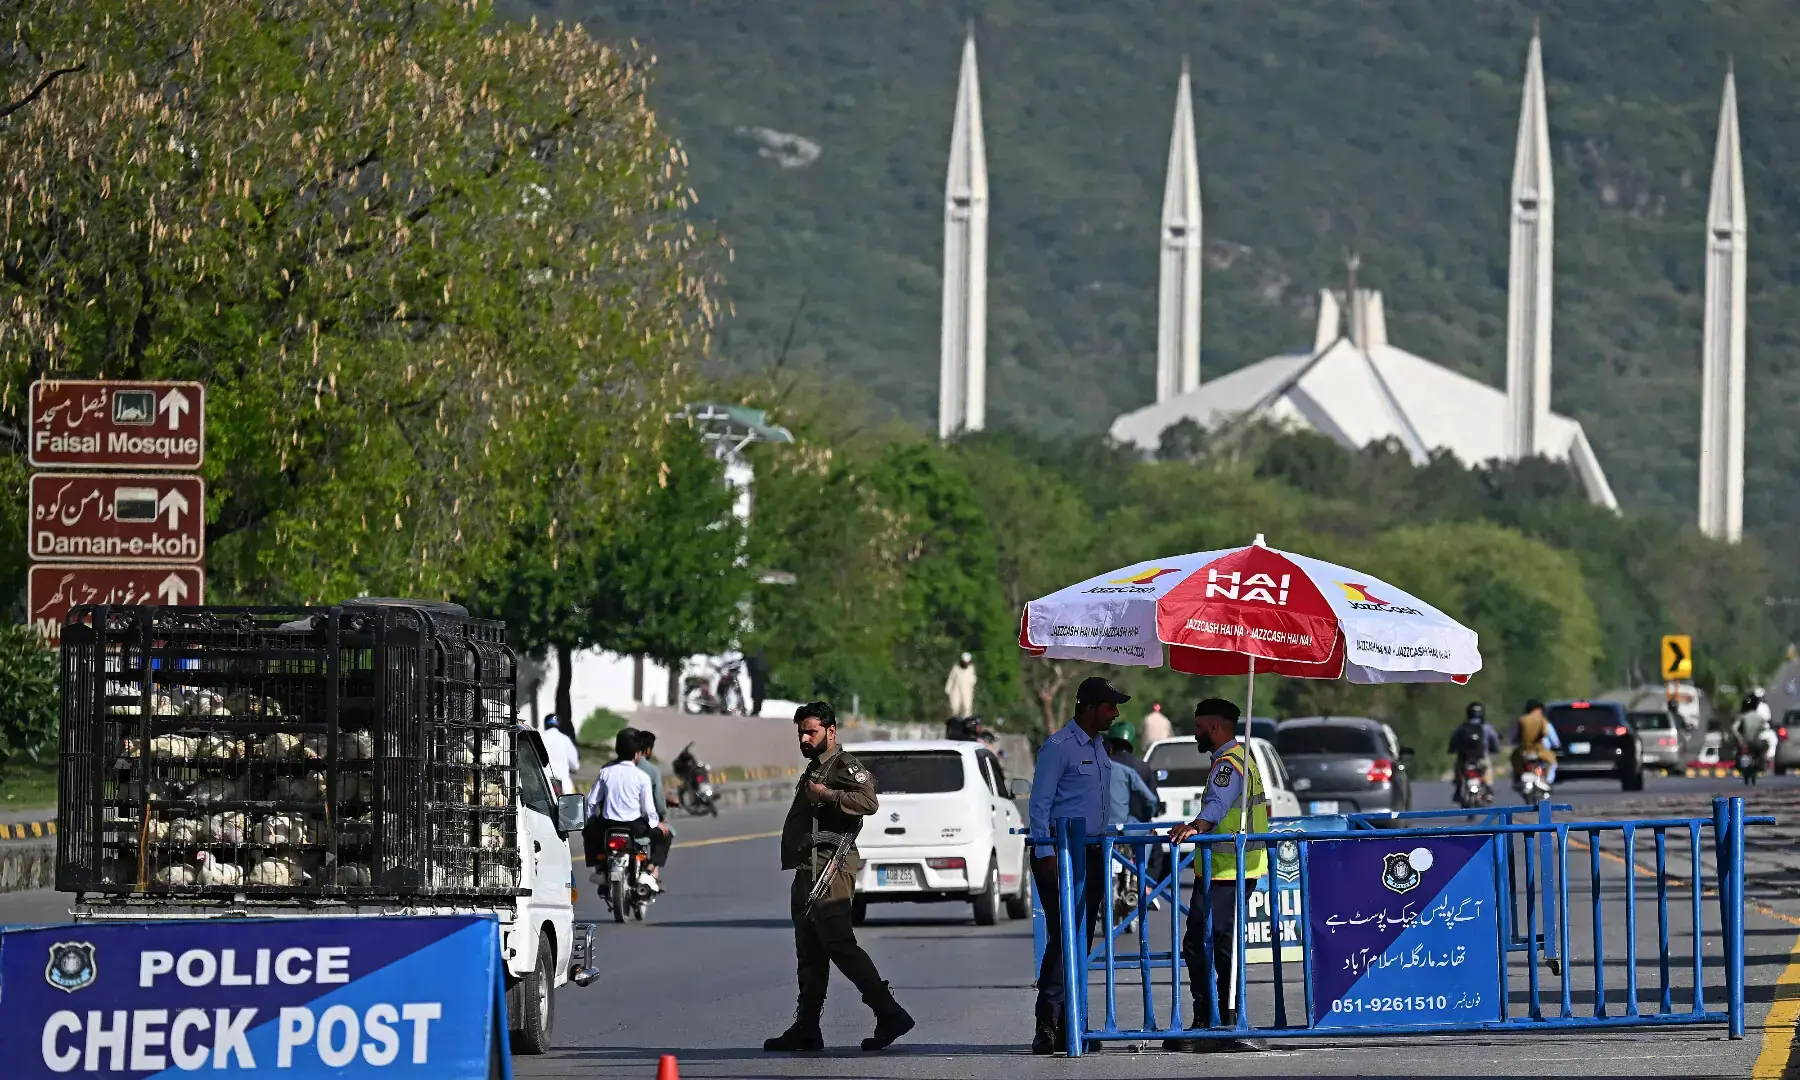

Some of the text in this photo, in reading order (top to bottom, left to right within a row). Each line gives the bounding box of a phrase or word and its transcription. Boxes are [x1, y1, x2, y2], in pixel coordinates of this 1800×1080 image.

[35, 387, 107, 431] فیصل مسجد
[35, 431, 198, 458] Faisal Mosque
[36, 480, 114, 526] دامن کوہ
[37, 531, 197, 555] Daman-e-koh
[1207, 568, 1291, 589] HAI
[1205, 583, 1289, 606] NA!
[1348, 600, 1424, 617] JazzCash
[1185, 618, 1313, 646] JAZZCASH HAI NA JAZZCASH HAI NA!
[1395, 646, 1428, 658] JAZZCASH
[1248, 889, 1302, 918] PLI
[1325, 894, 1484, 934] آگے پولیس چیک پوسٹ ہے
[1245, 919, 1298, 943] HEK
[138, 946, 351, 988] POLICE
[1342, 943, 1466, 979] تھانہ مارگلہ اسلام آباد
[1331, 990, 1481, 1013] فون نمبر 051-9261510
[41, 1003, 442, 1073] CHECK POST
